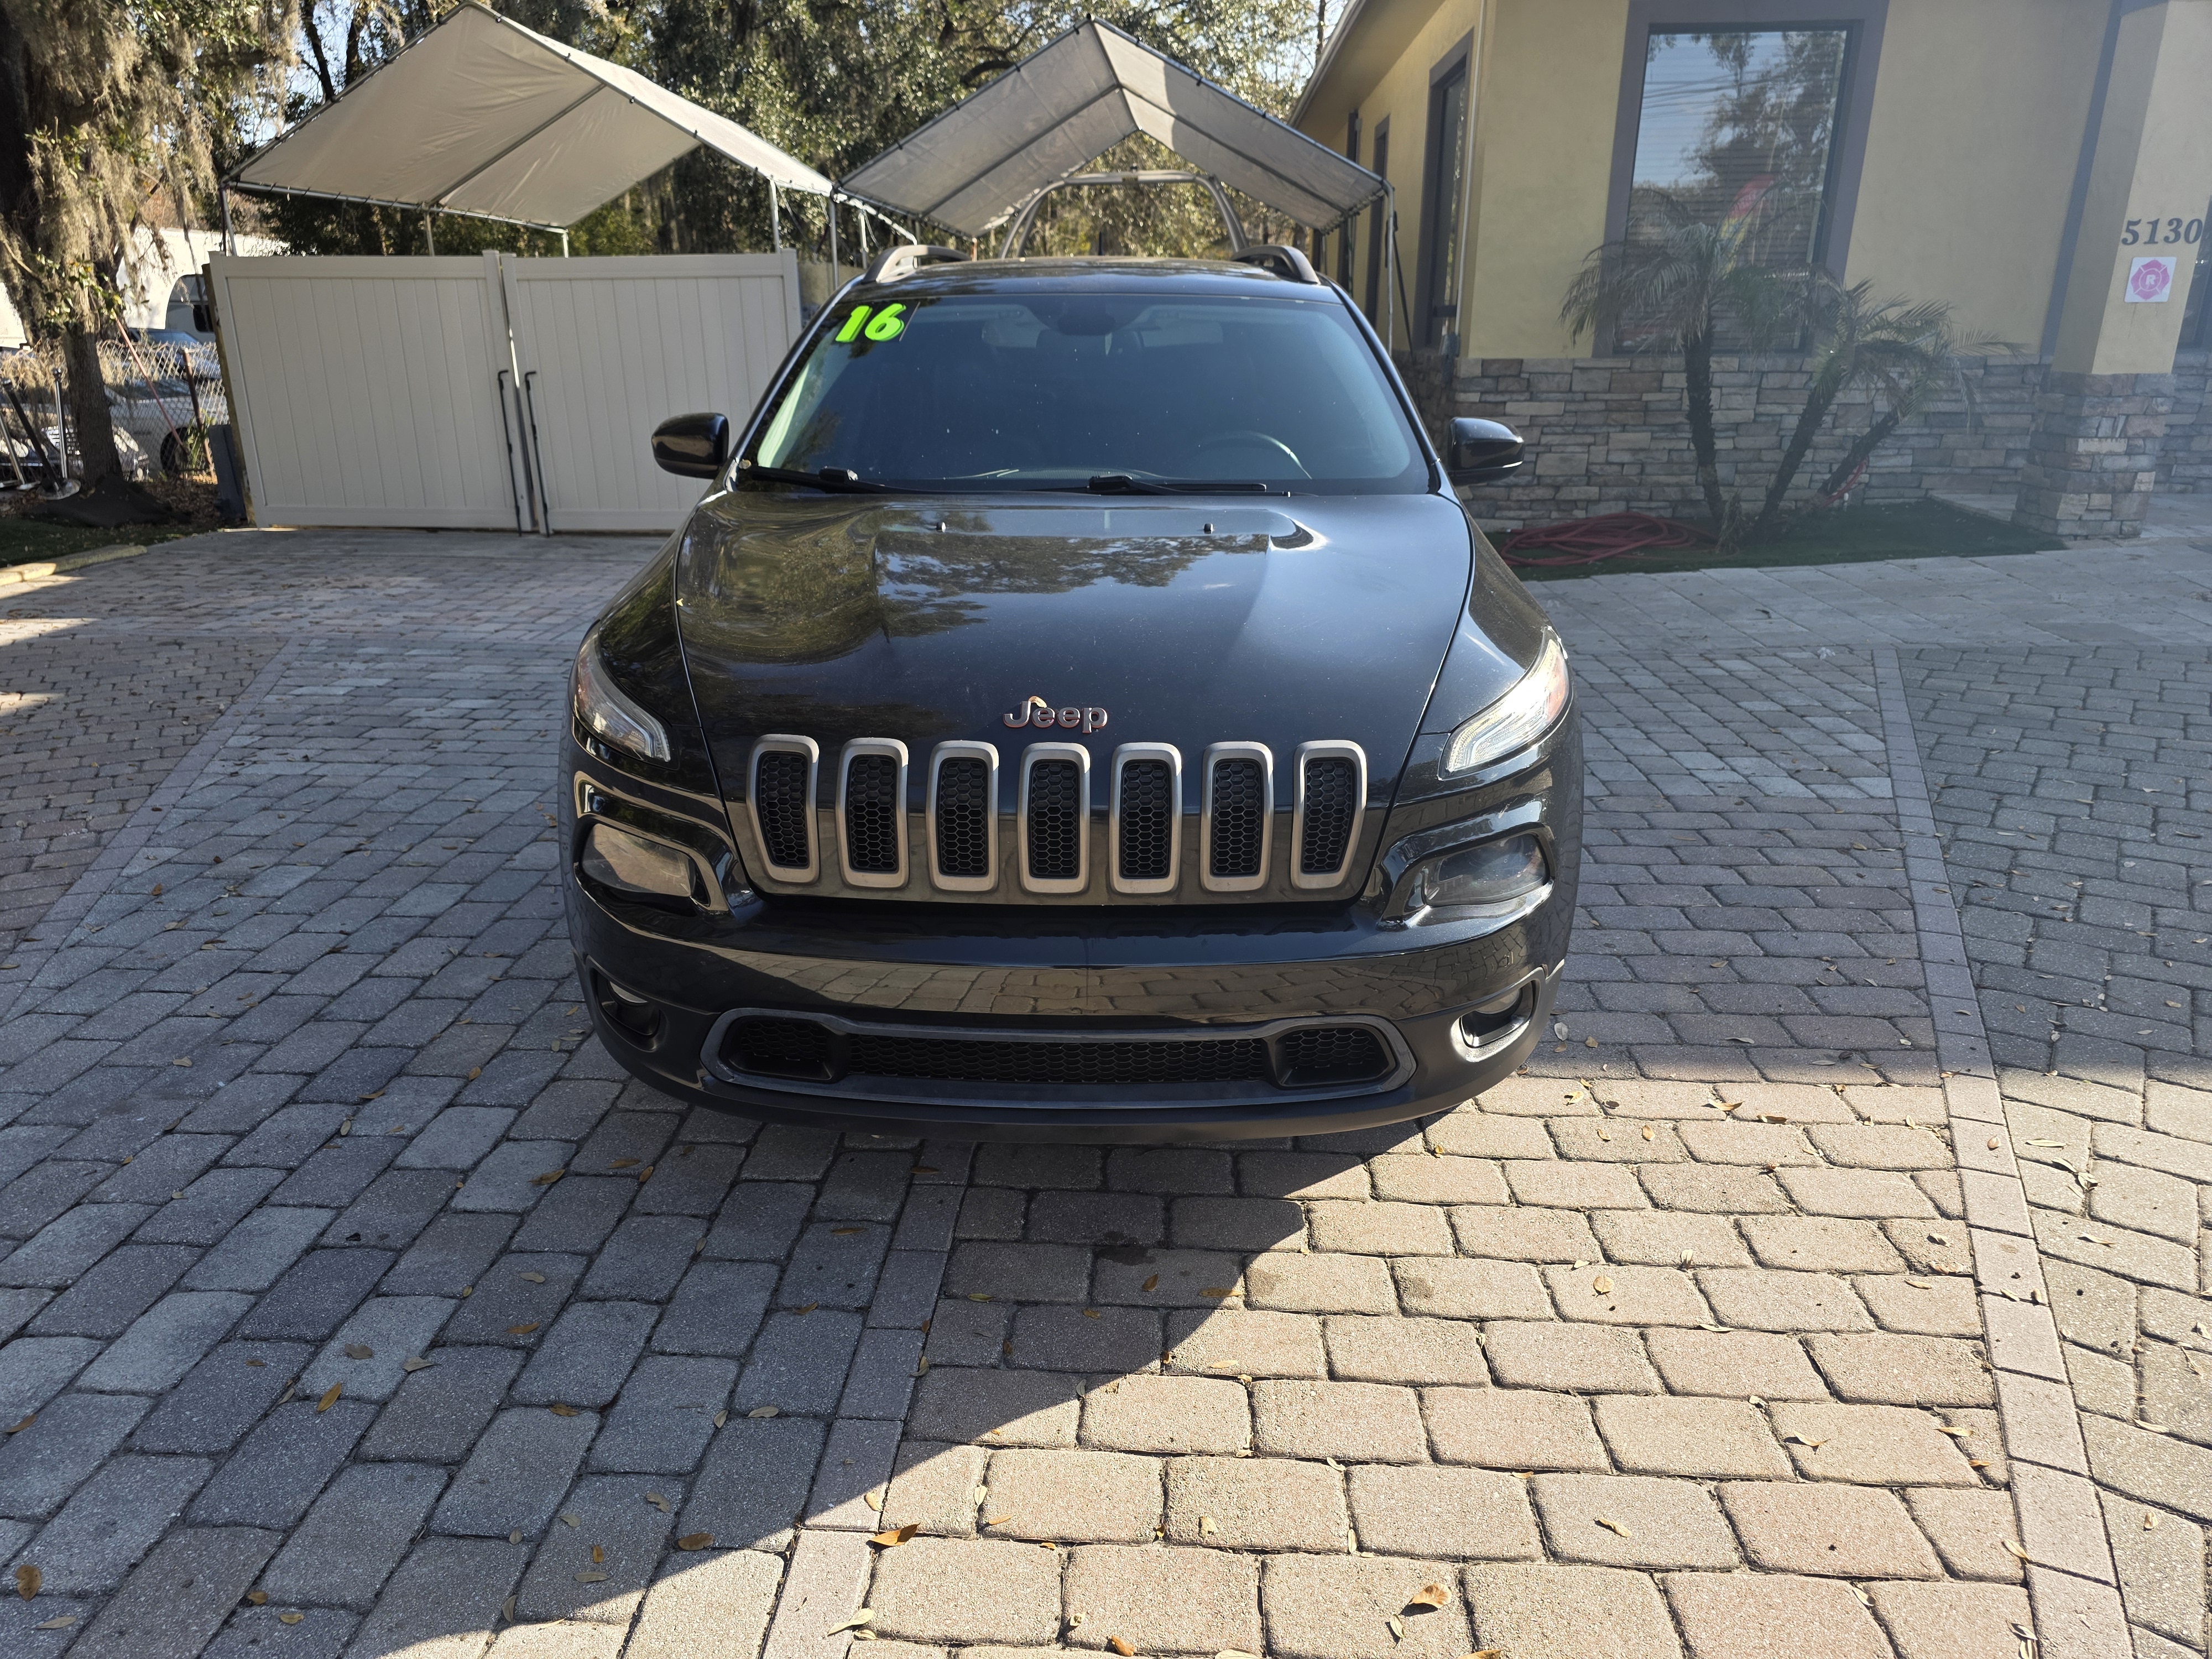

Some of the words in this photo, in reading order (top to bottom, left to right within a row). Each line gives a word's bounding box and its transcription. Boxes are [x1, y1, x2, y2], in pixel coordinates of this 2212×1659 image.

[2121, 217, 2203, 246] 5130
[2145, 274, 2156, 285] R
[835, 303, 906, 343] 16
[1003, 701, 1108, 734] Jeep
